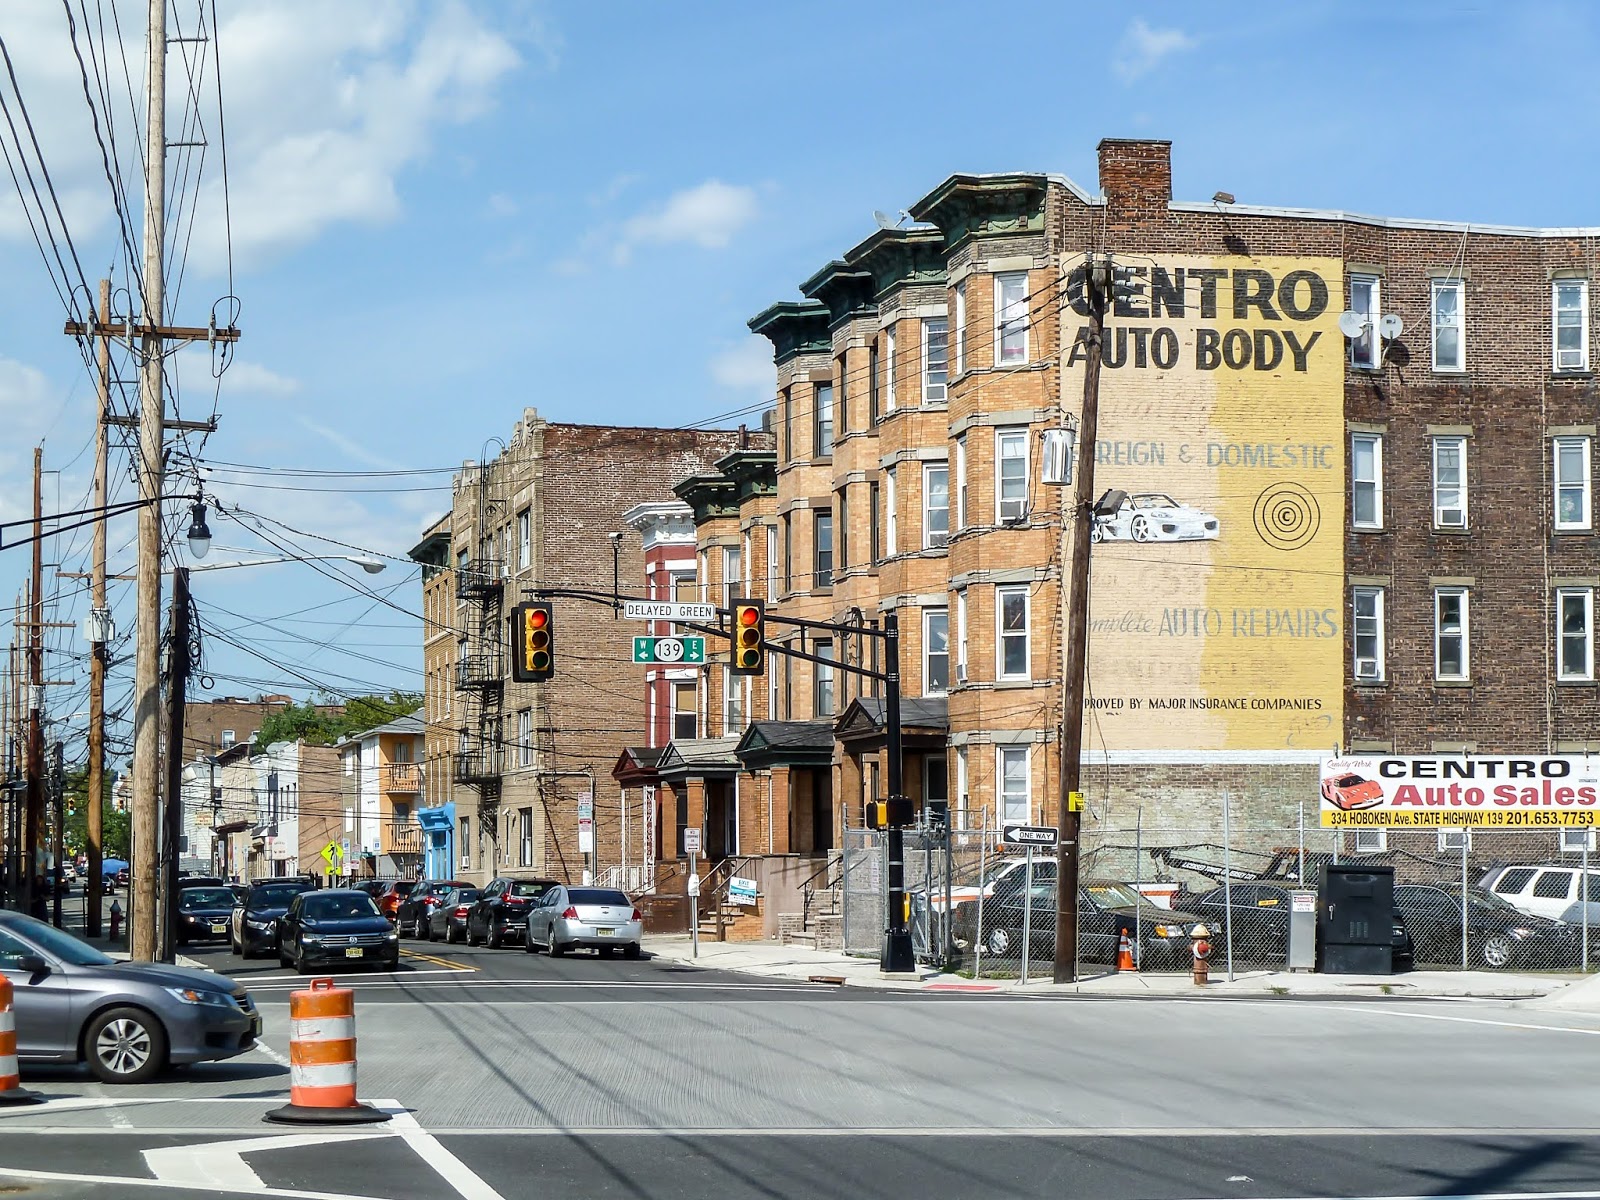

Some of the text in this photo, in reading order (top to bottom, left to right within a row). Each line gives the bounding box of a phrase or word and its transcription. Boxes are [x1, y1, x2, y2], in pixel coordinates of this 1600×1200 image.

[1067, 266, 1328, 321] CENTRO
[1066, 326, 1322, 372] AUTO BODY
[1074, 441, 1333, 469] REIGN & DOMESTIC
[628, 605, 712, 617] DELAYED GREEN
[1090, 608, 1338, 639] mplete AUTO REPAIRS
[639, 640, 698, 657] W 139 E
[1084, 698, 1322, 710] PROVED BY MAJOR INSURANCE COMPANIES
[1379, 760, 1570, 778] CENTRO
[1391, 780, 1597, 806] Auto Sales
[1331, 811, 1594, 825] 334 HOBOKEN Ave. STATE HIGHWAY 139 201.653.7753
[1036, 832, 1052, 840] WAY
